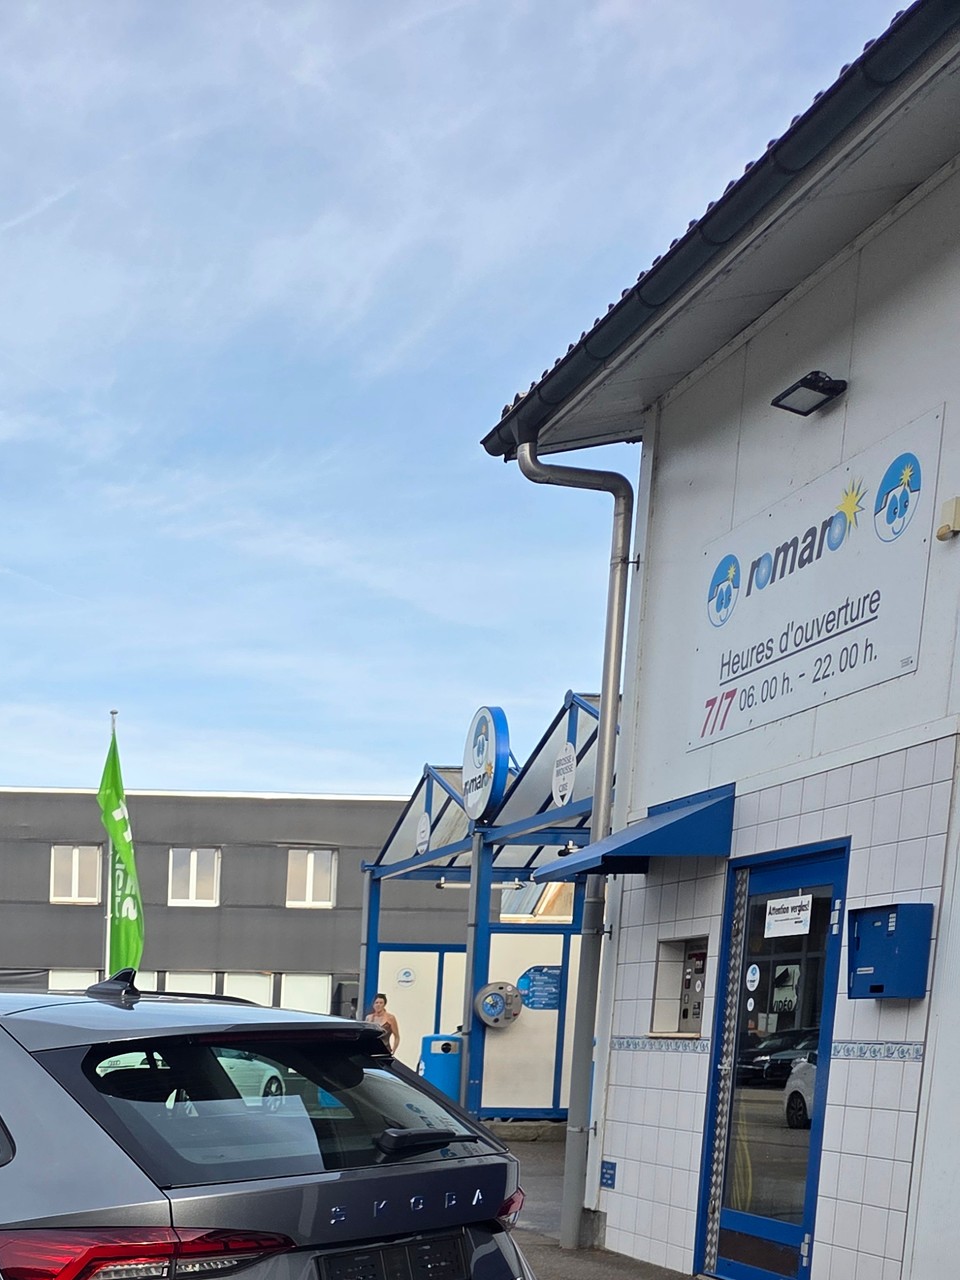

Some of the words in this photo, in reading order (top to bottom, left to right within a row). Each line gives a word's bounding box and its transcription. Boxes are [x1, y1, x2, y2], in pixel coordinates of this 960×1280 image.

[746, 511, 847, 597] romaro
[720, 638, 773, 680] Heures
[779, 589, 881, 653] d'ouverture
[701, 688, 737, 738] 7/7
[768, 904, 789, 916] Attention
